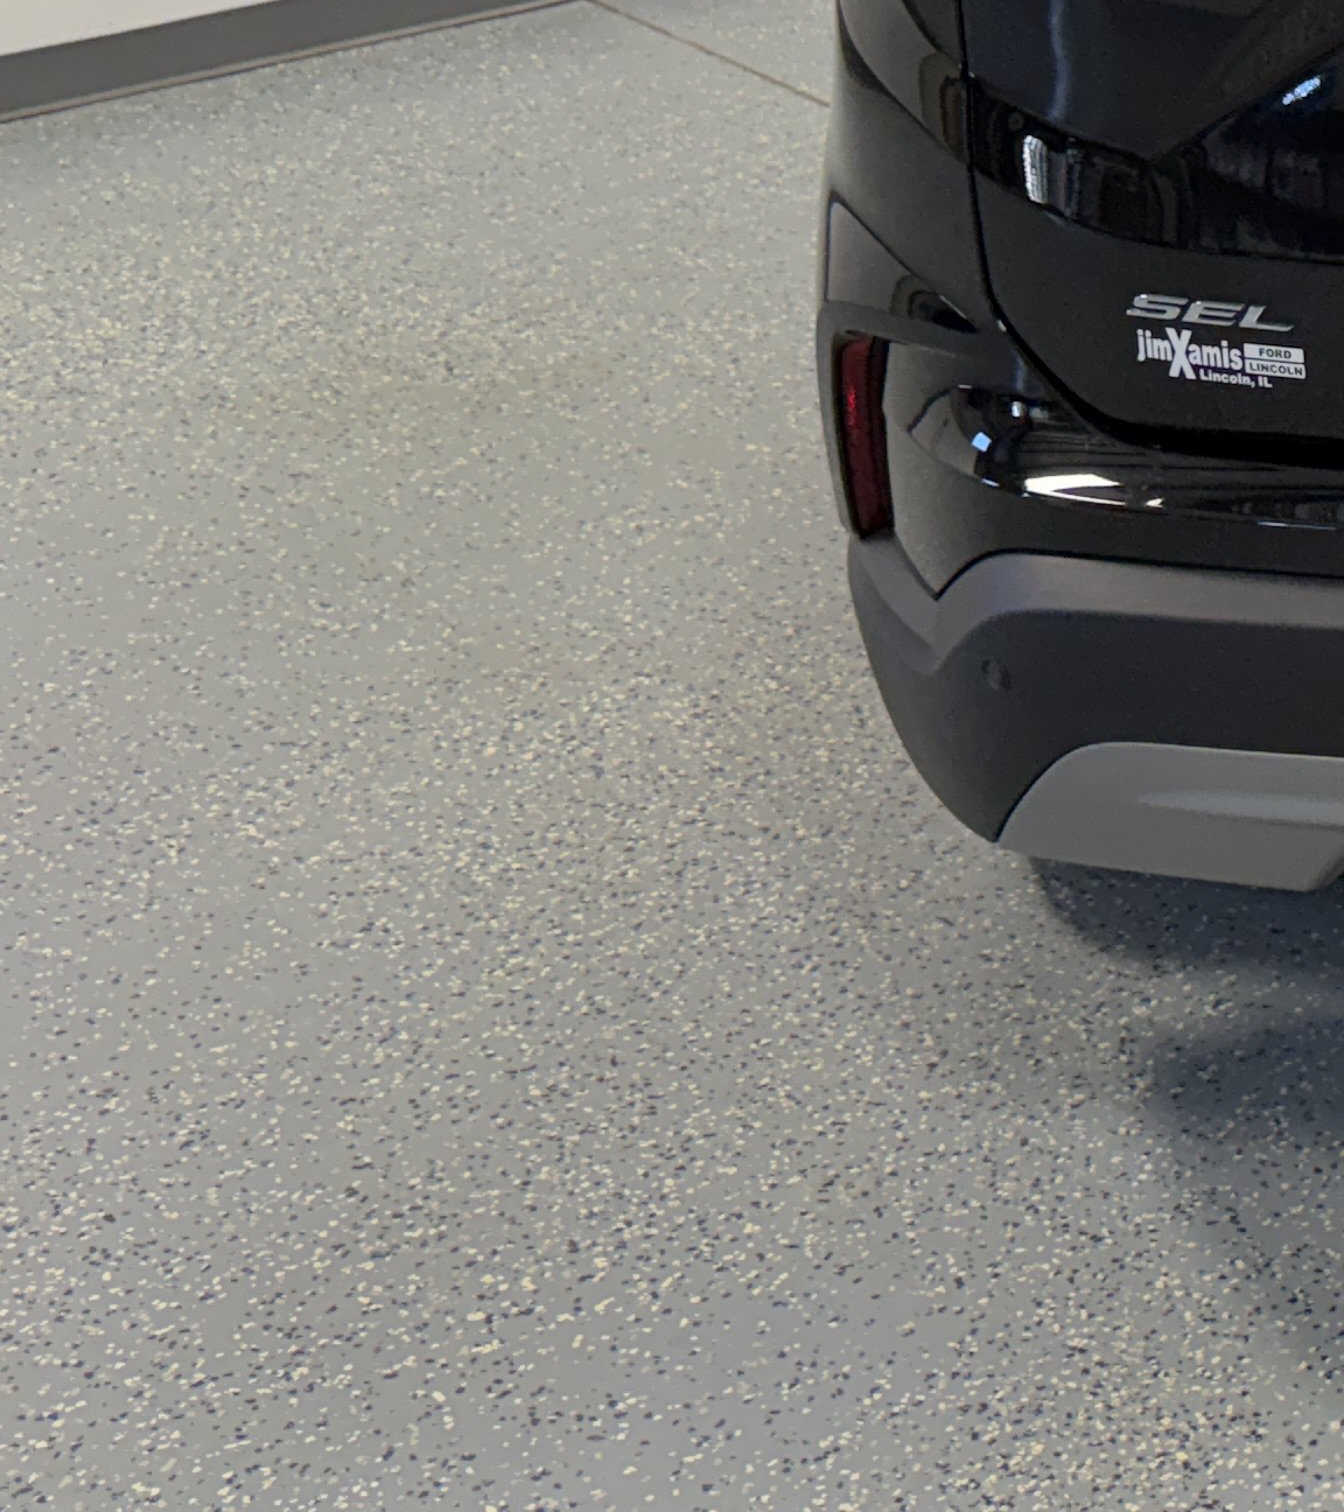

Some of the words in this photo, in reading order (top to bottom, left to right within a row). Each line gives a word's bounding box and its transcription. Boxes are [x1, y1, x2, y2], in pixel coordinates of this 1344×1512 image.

[1126, 293, 1295, 332] SEL
[1257, 346, 1292, 360] FORD
[1249, 361, 1304, 376] LINCOLN
[1199, 369, 1256, 388] Lincoln,
[1257, 376, 1273, 388] IL
